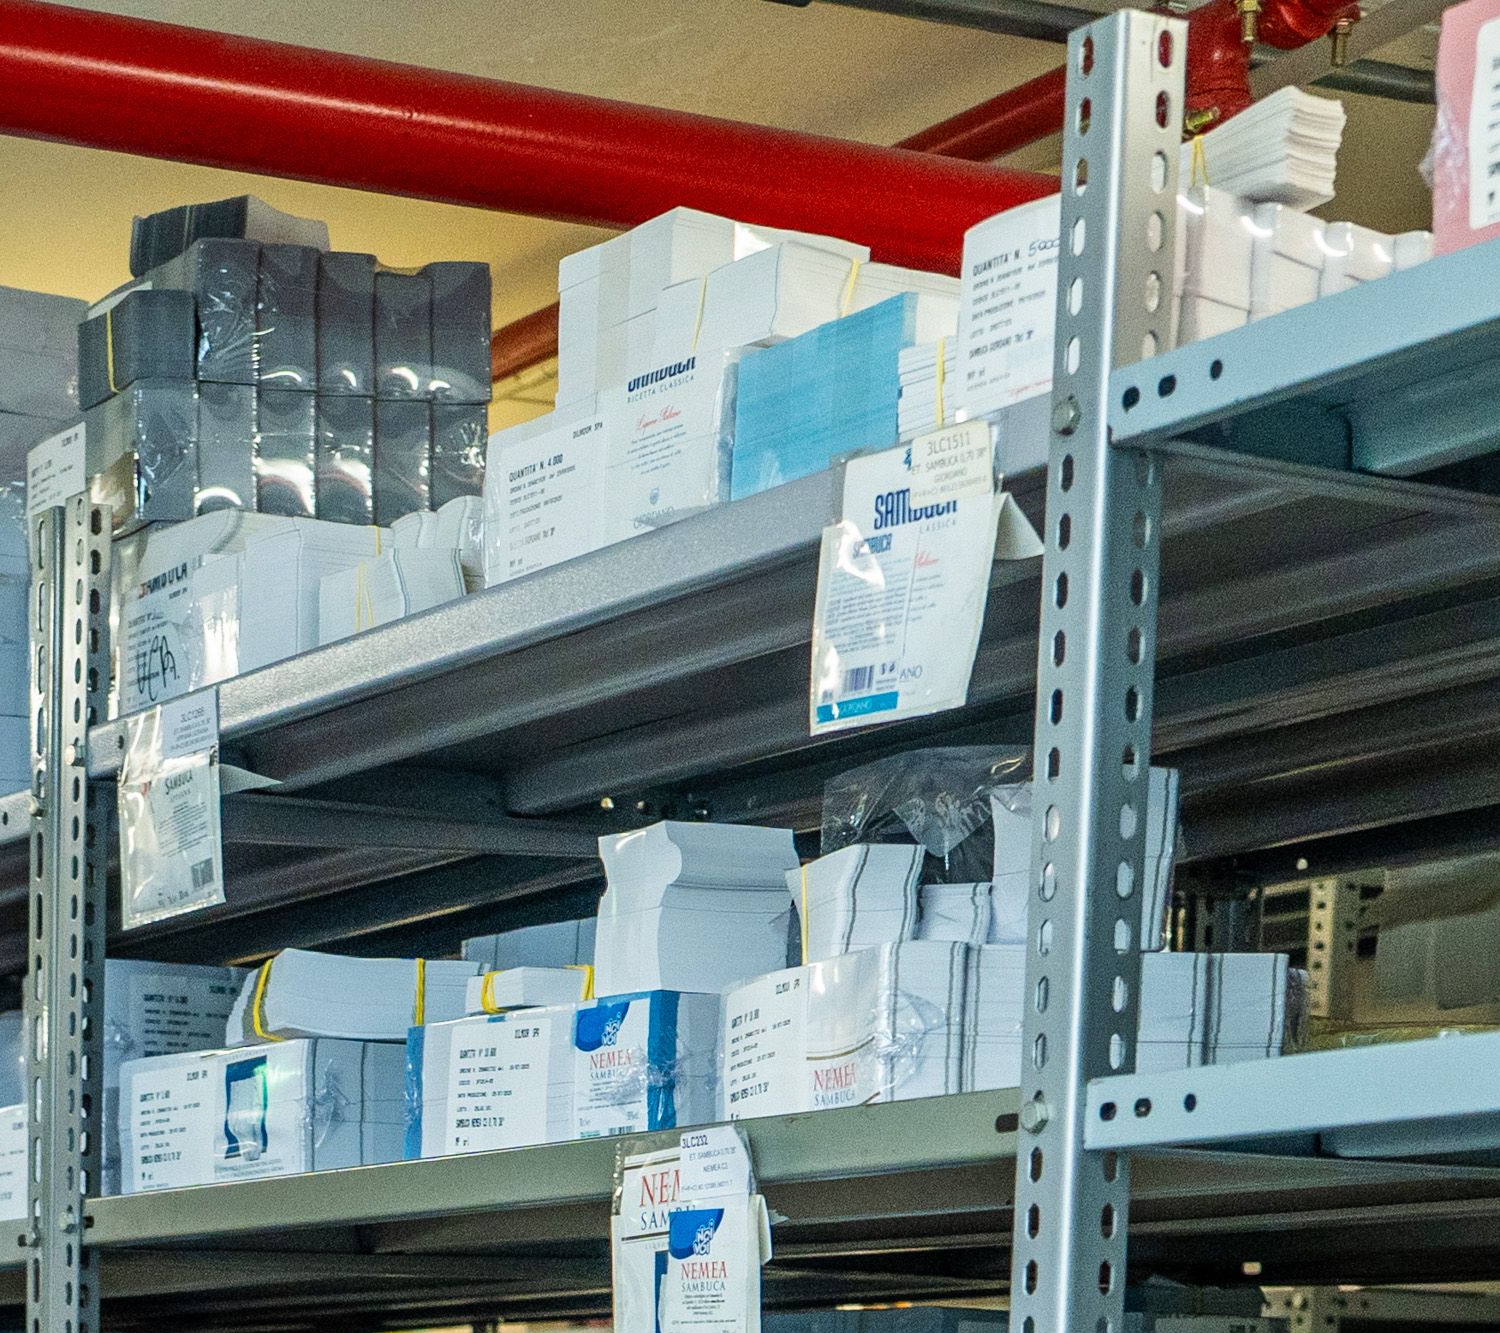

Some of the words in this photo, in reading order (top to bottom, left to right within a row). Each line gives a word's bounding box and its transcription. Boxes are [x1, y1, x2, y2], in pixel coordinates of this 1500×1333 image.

[589, 1051, 632, 1070] NEMEA
[813, 1064, 857, 1092] NEMEA
[681, 1261, 728, 1279] NEMEA
[681, 1279, 727, 1293] SAMBUCA
